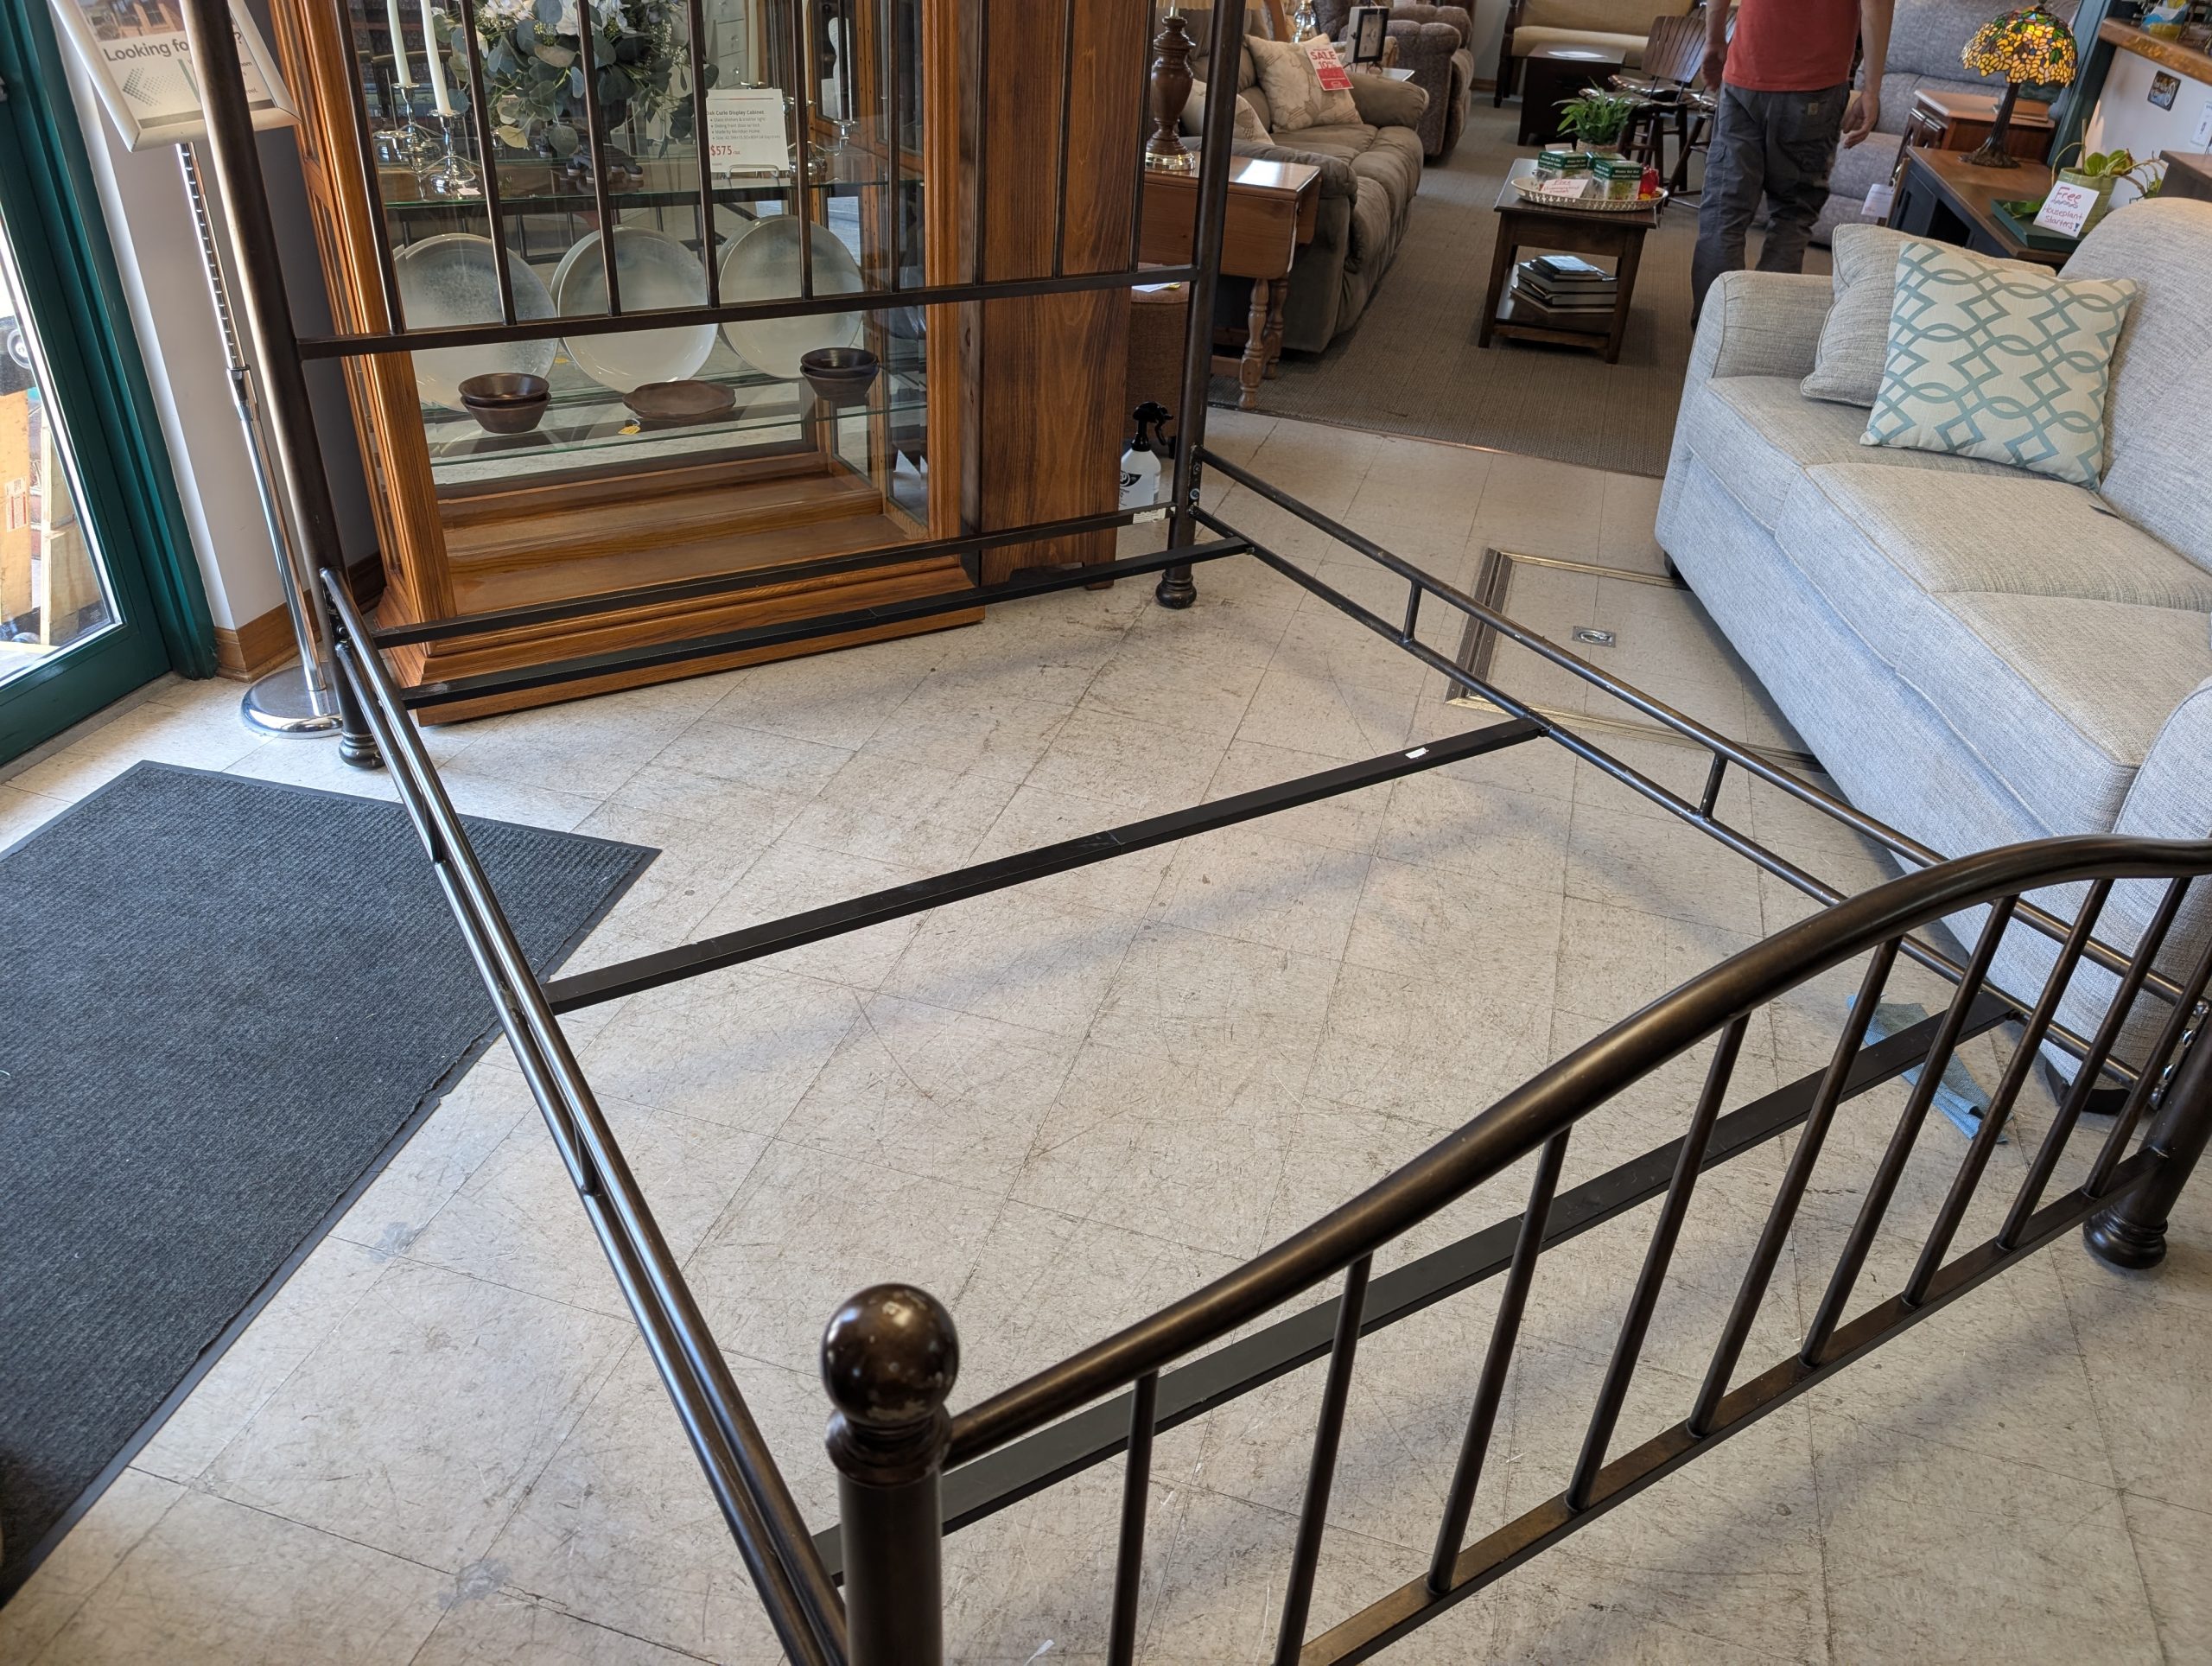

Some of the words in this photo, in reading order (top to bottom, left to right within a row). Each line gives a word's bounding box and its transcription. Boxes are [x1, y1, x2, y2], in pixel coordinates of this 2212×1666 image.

[104, 41, 171, 62] Looking
[172, 39, 190, 53] fo
[1310, 51, 1336, 60] SALE
[710, 144, 733, 156] $575
[2054, 186, 2082, 205] Free
[2043, 203, 2083, 220] Houseplant
